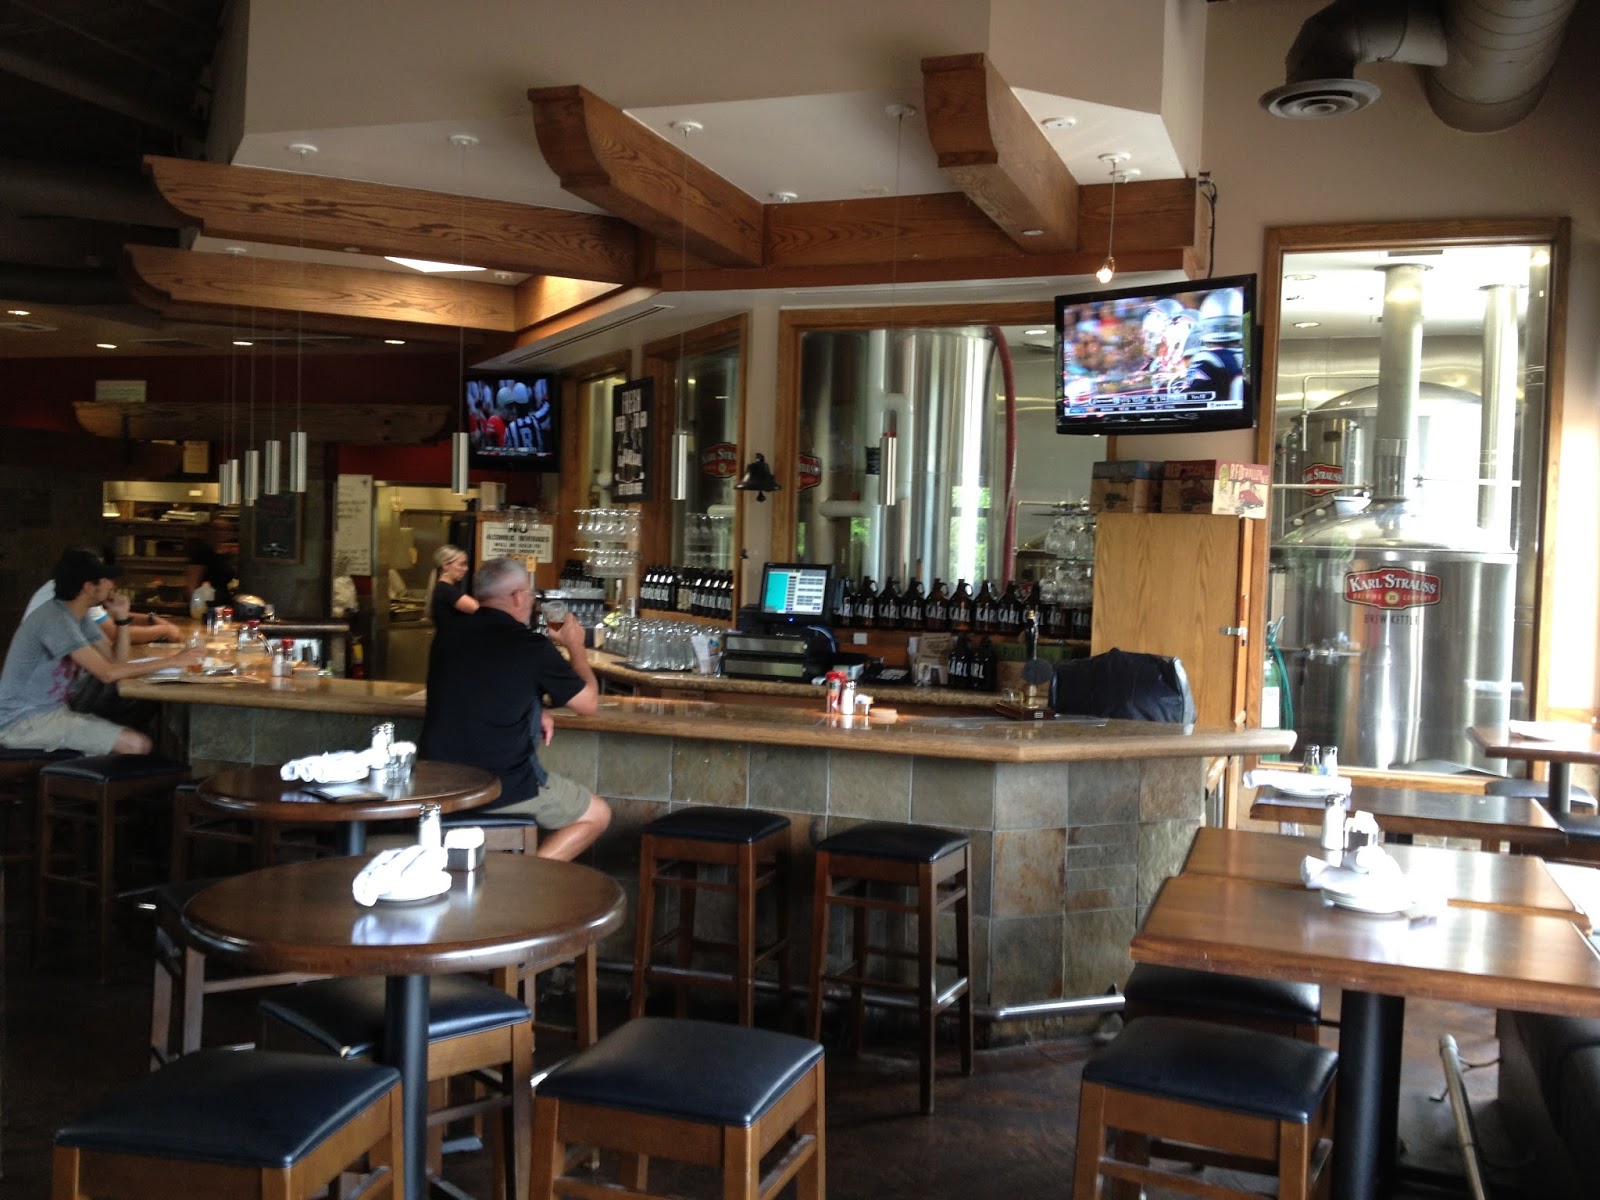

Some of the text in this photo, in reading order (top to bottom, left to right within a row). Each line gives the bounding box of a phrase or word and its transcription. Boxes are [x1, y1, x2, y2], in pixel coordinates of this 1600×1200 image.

[1350, 573, 1437, 595] KARL STRAUSS
[998, 608, 1019, 625] KARL
